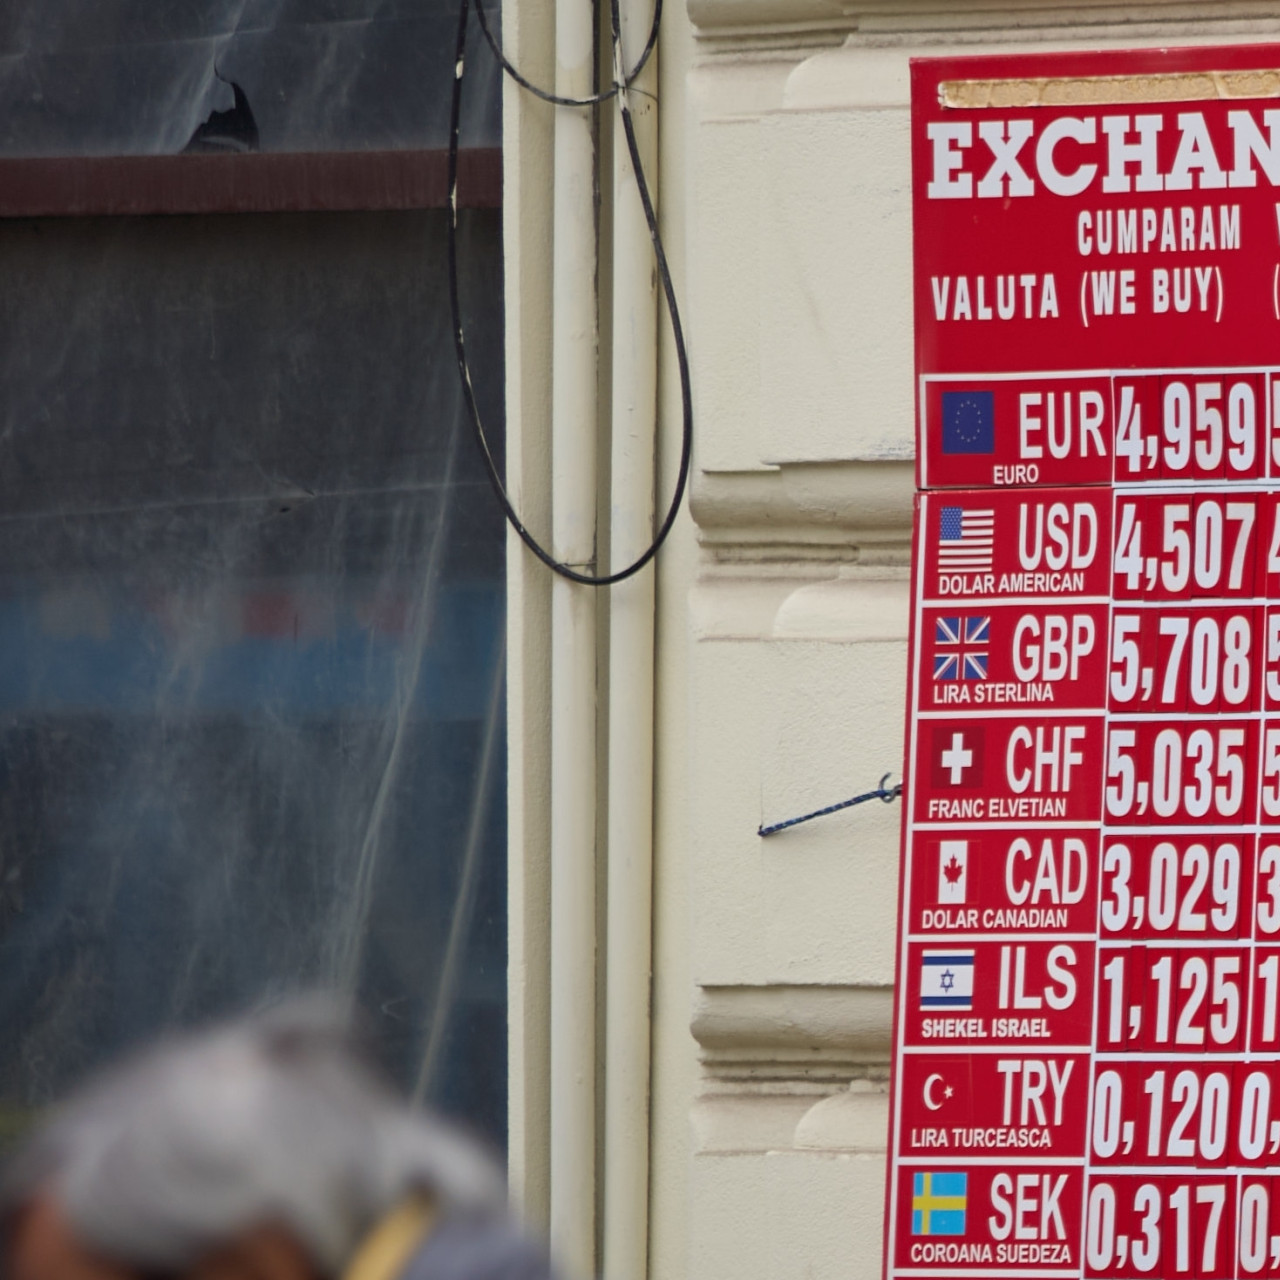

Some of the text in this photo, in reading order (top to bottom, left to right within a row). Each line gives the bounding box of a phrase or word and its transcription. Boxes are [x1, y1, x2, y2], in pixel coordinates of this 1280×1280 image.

[1077, 204, 1241, 256] CUMPARAM
[931, 273, 1060, 322] VALUTA
[1080, 265, 1223, 327] (WE BUY)
[1019, 390, 1108, 459] EUR
[1115, 381, 1256, 472] 4,959
[993, 464, 1039, 485] EURO
[1019, 503, 1099, 571] USD
[1114, 500, 1255, 592] 4,507
[938, 572, 1084, 595] DOLAR AMERICAN
[1012, 613, 1096, 683] GBP
[1110, 614, 1252, 706] 5,708
[934, 683, 1054, 705] LIRA STERLINA
[1006, 725, 1086, 795] CHF
[1105, 727, 1246, 818] 5,035
[928, 798, 1067, 819] FRANC ELVETIAN
[1005, 837, 1089, 907] CAD
[1101, 843, 1240, 932] 3,029
[922, 909, 1068, 930] DOLAR CANADIAN
[999, 944, 1078, 1012] ILS
[1104, 955, 1240, 1046] 1,125
[921, 1019, 1051, 1039] SHEKEL ISRAEL
[997, 1059, 1075, 1127] TRY
[1093, 1069, 1230, 1161] 0,120
[911, 1128, 1052, 1148] LIRA TURCEASCA
[989, 1173, 1069, 1241] SEK
[1085, 1183, 1227, 1274] 0,317
[910, 1244, 1072, 1264] COROANA SUEDEZA
